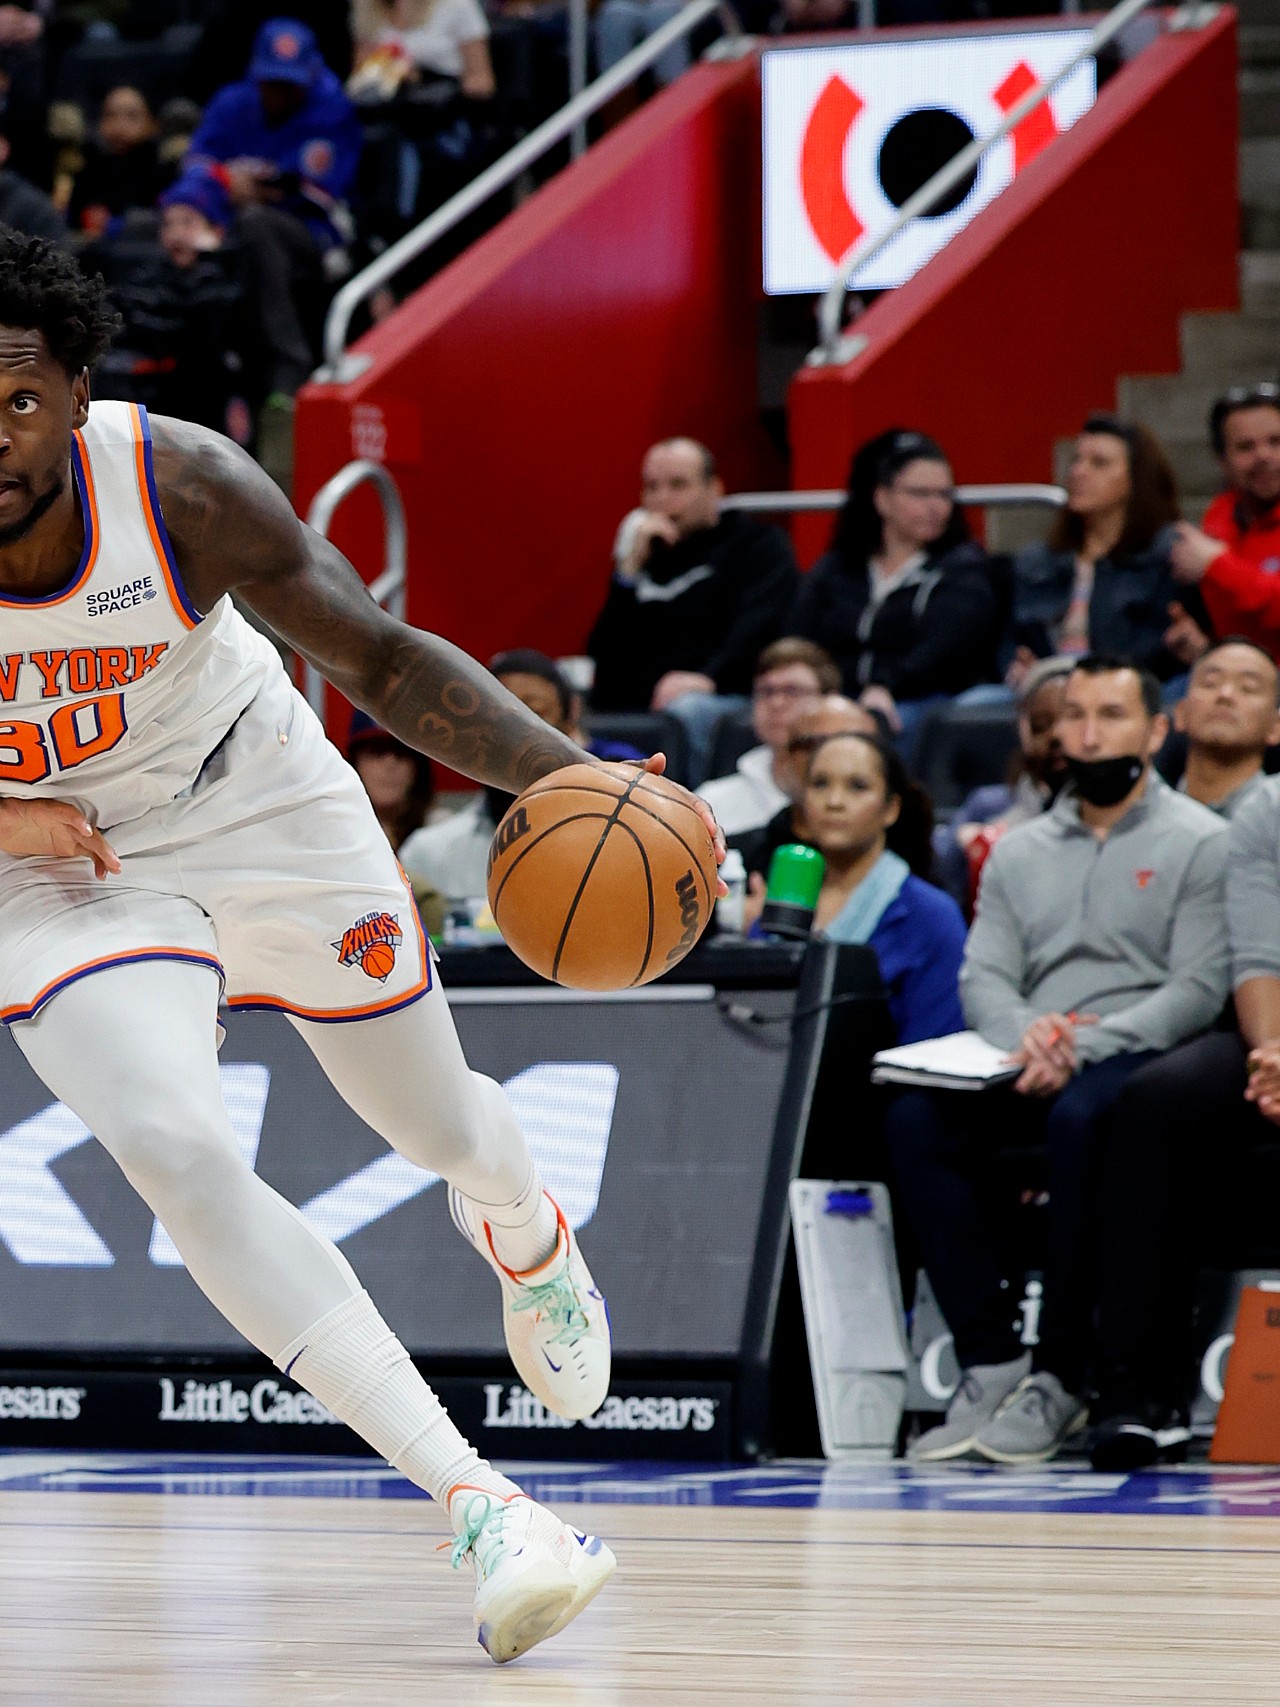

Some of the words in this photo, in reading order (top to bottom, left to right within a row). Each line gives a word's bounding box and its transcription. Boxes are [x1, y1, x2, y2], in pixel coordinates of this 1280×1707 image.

[86, 576, 153, 605] SQUARE
[87, 593, 141, 617] SPACE
[28, 640, 171, 699] YORK
[337, 912, 404, 966] KNICKS
[158, 1378, 250, 1423] Little
[249, 1379, 347, 1425] Caes
[482, 1384, 578, 1429] Litt
